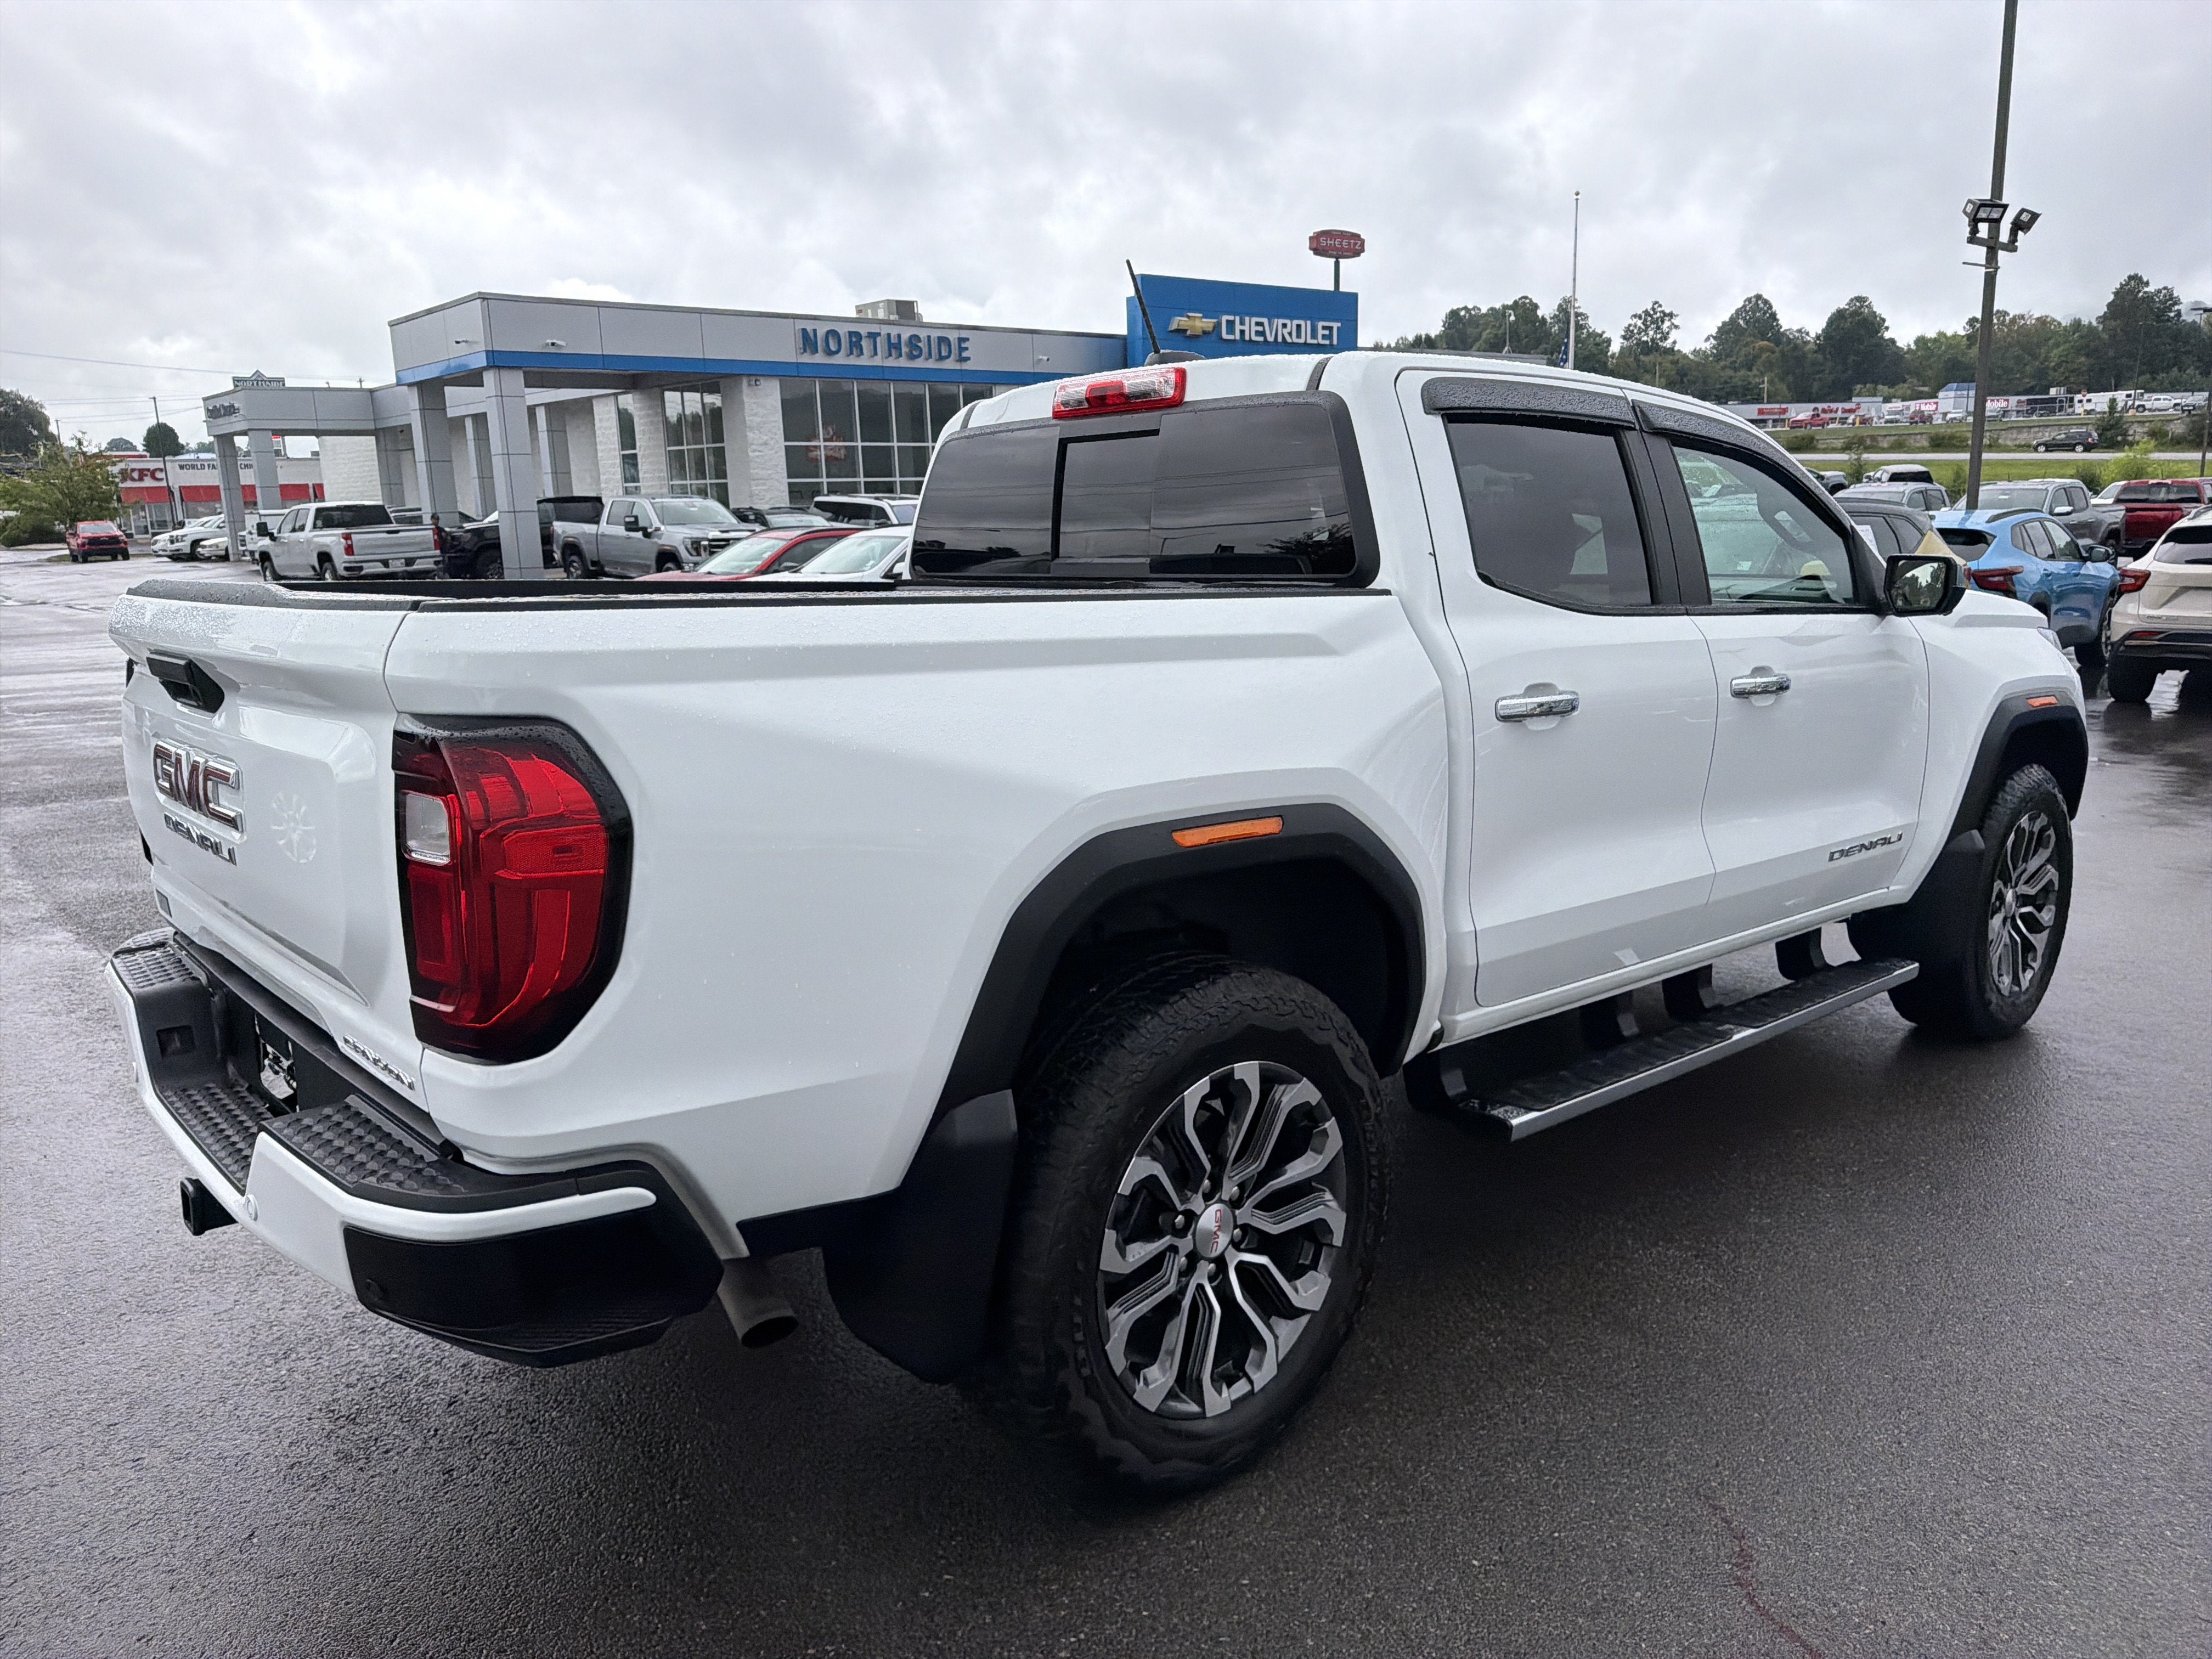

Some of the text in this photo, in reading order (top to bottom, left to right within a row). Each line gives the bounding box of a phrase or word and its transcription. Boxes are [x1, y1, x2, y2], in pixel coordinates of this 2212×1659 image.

[1320, 238, 1362, 250] SHEETZ
[799, 327, 971, 362] NORTHSIDE
[1221, 314, 1341, 346] CHEVROLET
[120, 468, 165, 482] KFC
[154, 741, 245, 834] GMC
[164, 812, 237, 866] DENALI
[1828, 831, 1903, 862] DENALI
[343, 1034, 415, 1092] CANYON
[1210, 1209, 1222, 1254] GMC
